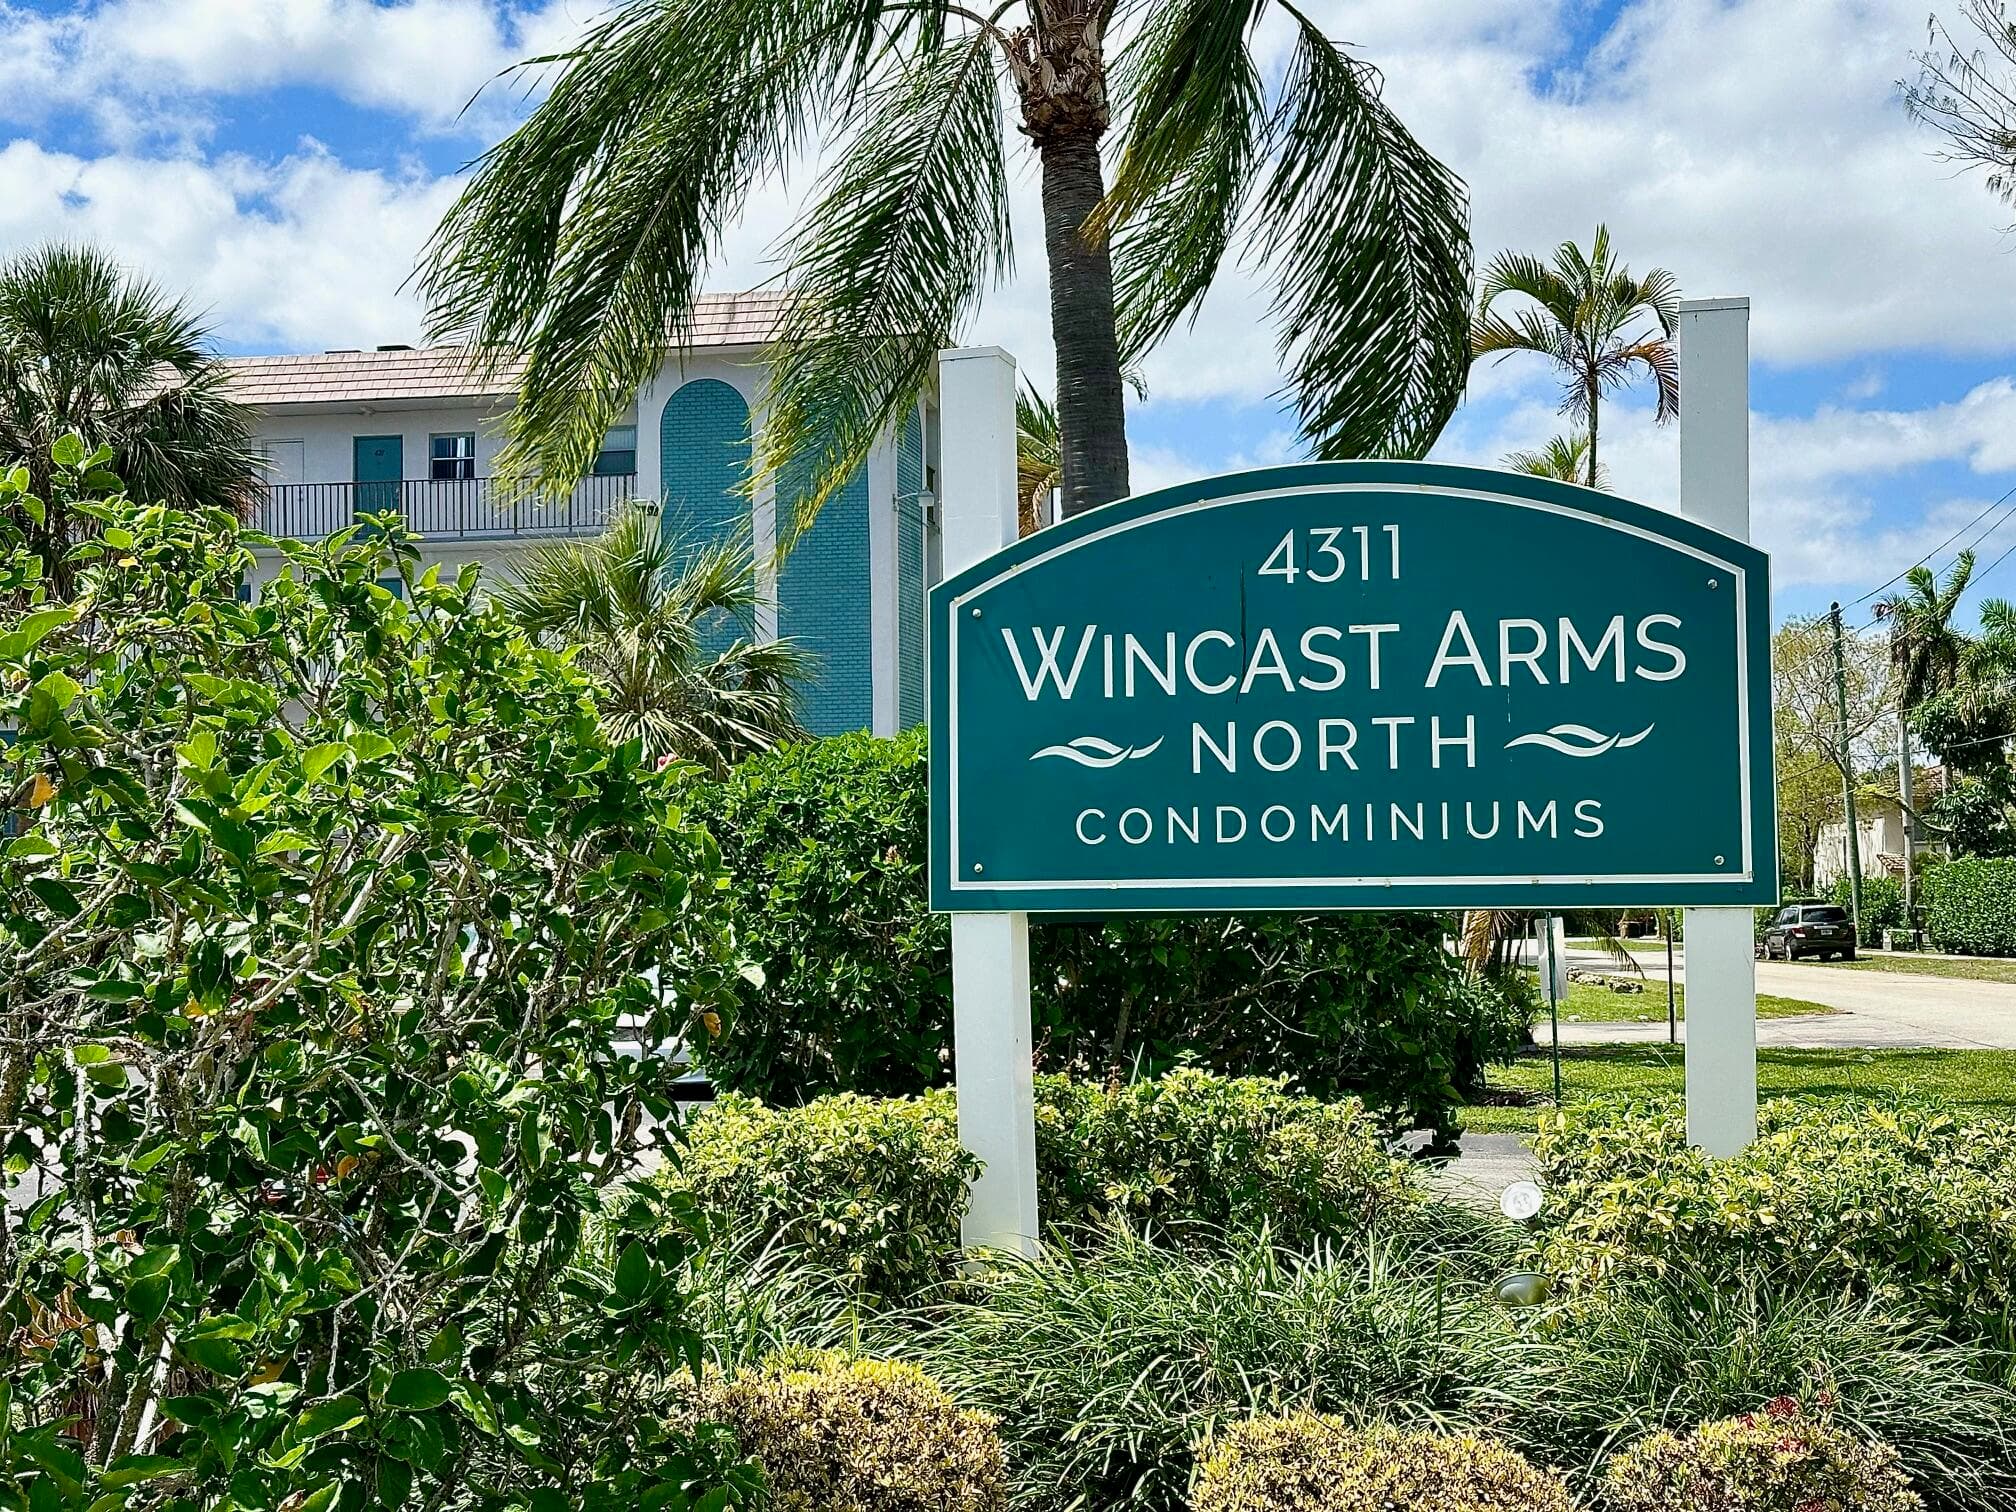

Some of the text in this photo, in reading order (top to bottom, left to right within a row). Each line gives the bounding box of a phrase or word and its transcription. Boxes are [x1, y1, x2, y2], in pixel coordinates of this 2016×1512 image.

[1258, 525, 1400, 584] 4311
[1001, 611, 1686, 701] WINCAST ARMS
[1192, 715, 1476, 774] NORTH
[1075, 800, 1605, 845] CONDOMINIUMS
